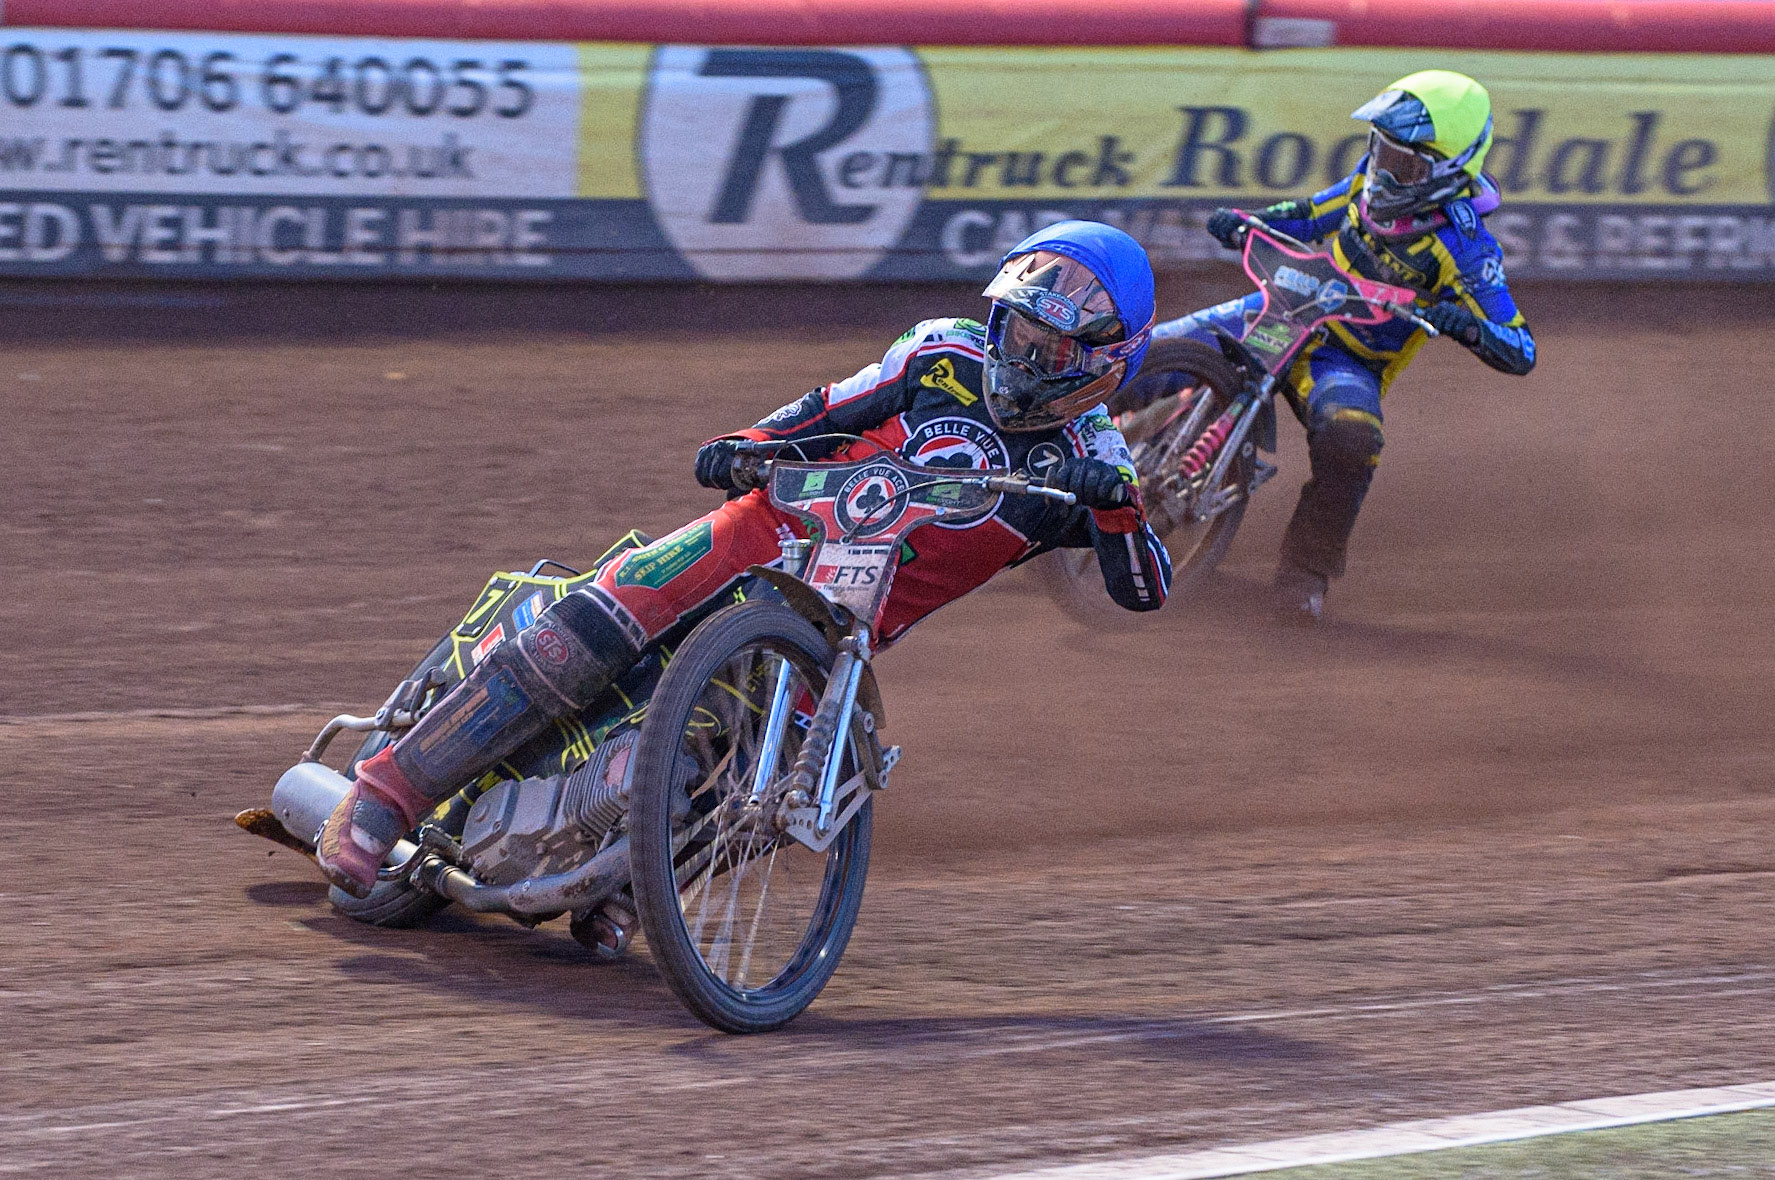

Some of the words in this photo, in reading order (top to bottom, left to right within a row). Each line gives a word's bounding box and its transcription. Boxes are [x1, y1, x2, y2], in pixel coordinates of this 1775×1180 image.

[2, 42, 239, 113] 01706
[263, 48, 535, 120] 640055
[694, 48, 1136, 224] Rentruck
[1160, 104, 1722, 197] Rocdale
[90, 204, 385, 266] VEHICLE
[398, 208, 553, 268] HIRE
[941, 208, 1069, 267] CA
[1038, 298, 1074, 321] STS
[924, 423, 971, 438] BELLE
[974, 431, 1000, 459] VUE
[843, 470, 869, 493] BELLE
[873, 468, 892, 477] VUE
[891, 475, 906, 493] ACE
[833, 565, 879, 585] FTS
[538, 633, 564, 660] STS
